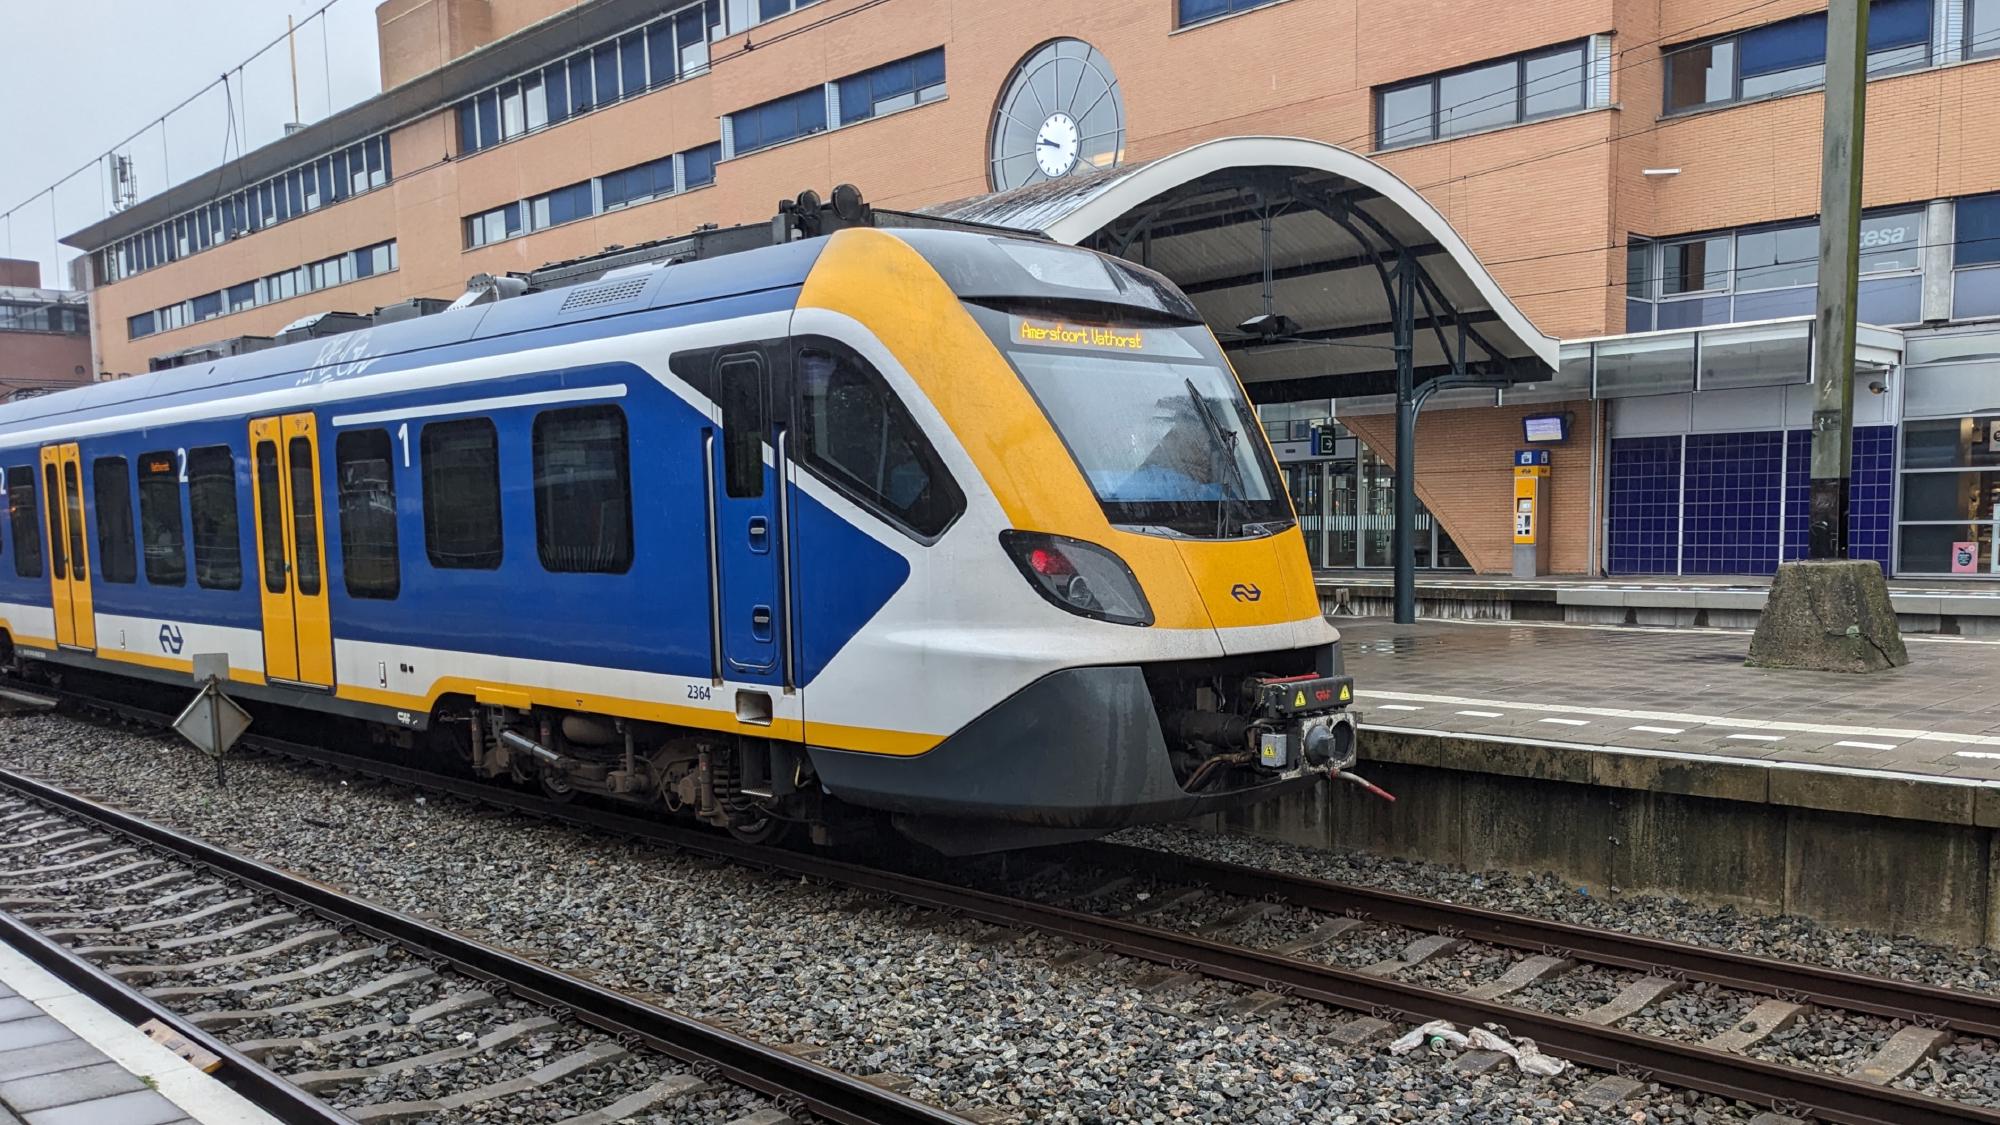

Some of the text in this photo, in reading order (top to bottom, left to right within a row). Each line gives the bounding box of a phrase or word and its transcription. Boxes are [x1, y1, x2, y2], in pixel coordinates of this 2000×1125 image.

[1021, 321, 1142, 349] Amersfoort Vathorst
[398, 422, 410, 468] 1
[177, 447, 189, 483] 2
[687, 685, 711, 701] 2364
